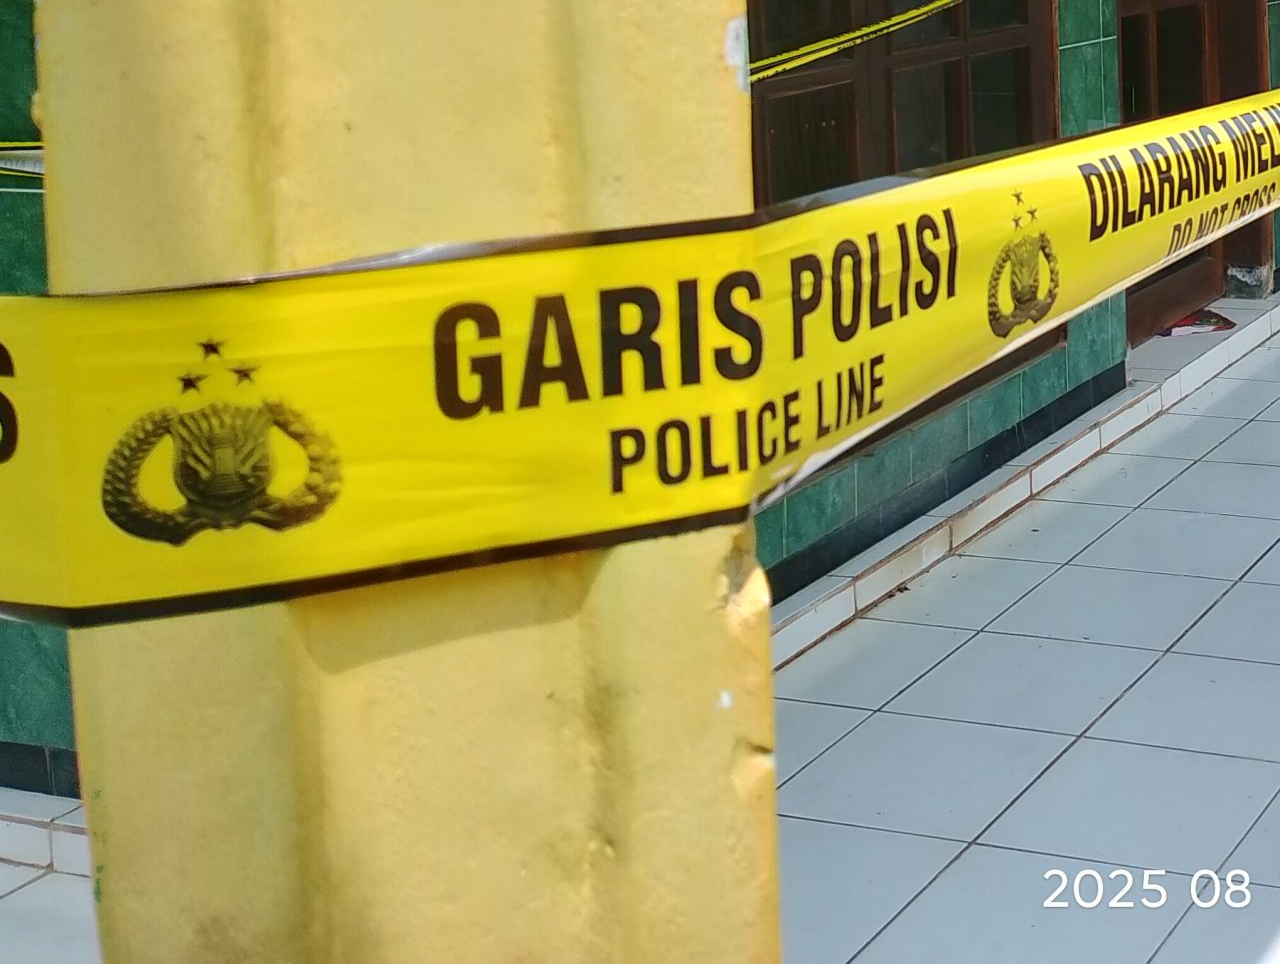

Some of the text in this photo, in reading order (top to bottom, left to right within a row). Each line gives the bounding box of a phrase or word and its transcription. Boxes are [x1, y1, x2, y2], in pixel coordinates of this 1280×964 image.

[1078, 124, 1227, 242] DILARANG
[1167, 217, 1193, 256] DO
[1195, 202, 1229, 242] NOT
[433, 207, 958, 420] GARIS POLISI
[610, 354, 884, 494] POLICE LINE
